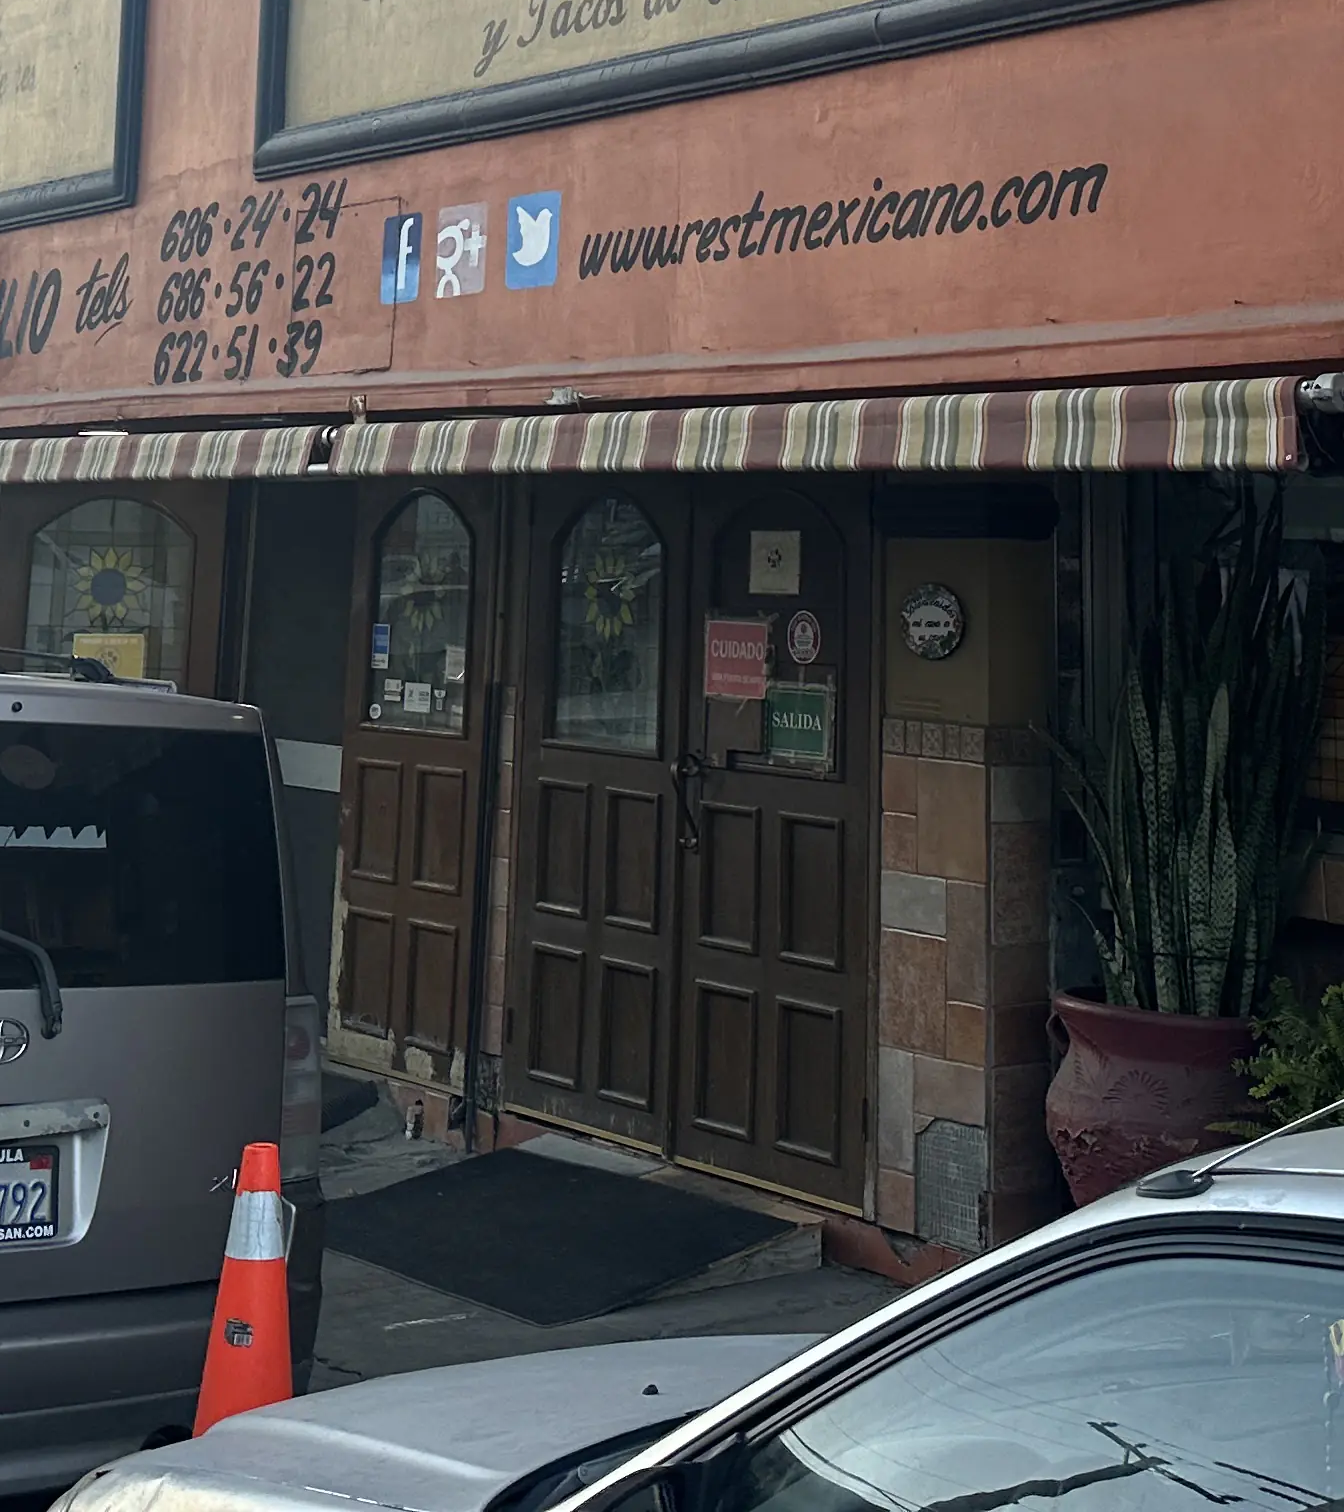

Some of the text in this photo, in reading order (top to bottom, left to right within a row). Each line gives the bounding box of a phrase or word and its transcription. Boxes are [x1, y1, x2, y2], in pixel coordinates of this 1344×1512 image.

[473, 18, 510, 79] y
[578, 163, 1109, 280] www.restmexicano.com
[75, 252, 134, 338] tels
[710, 639, 764, 661] CUIDADO
[771, 711, 822, 732] SALIDA
